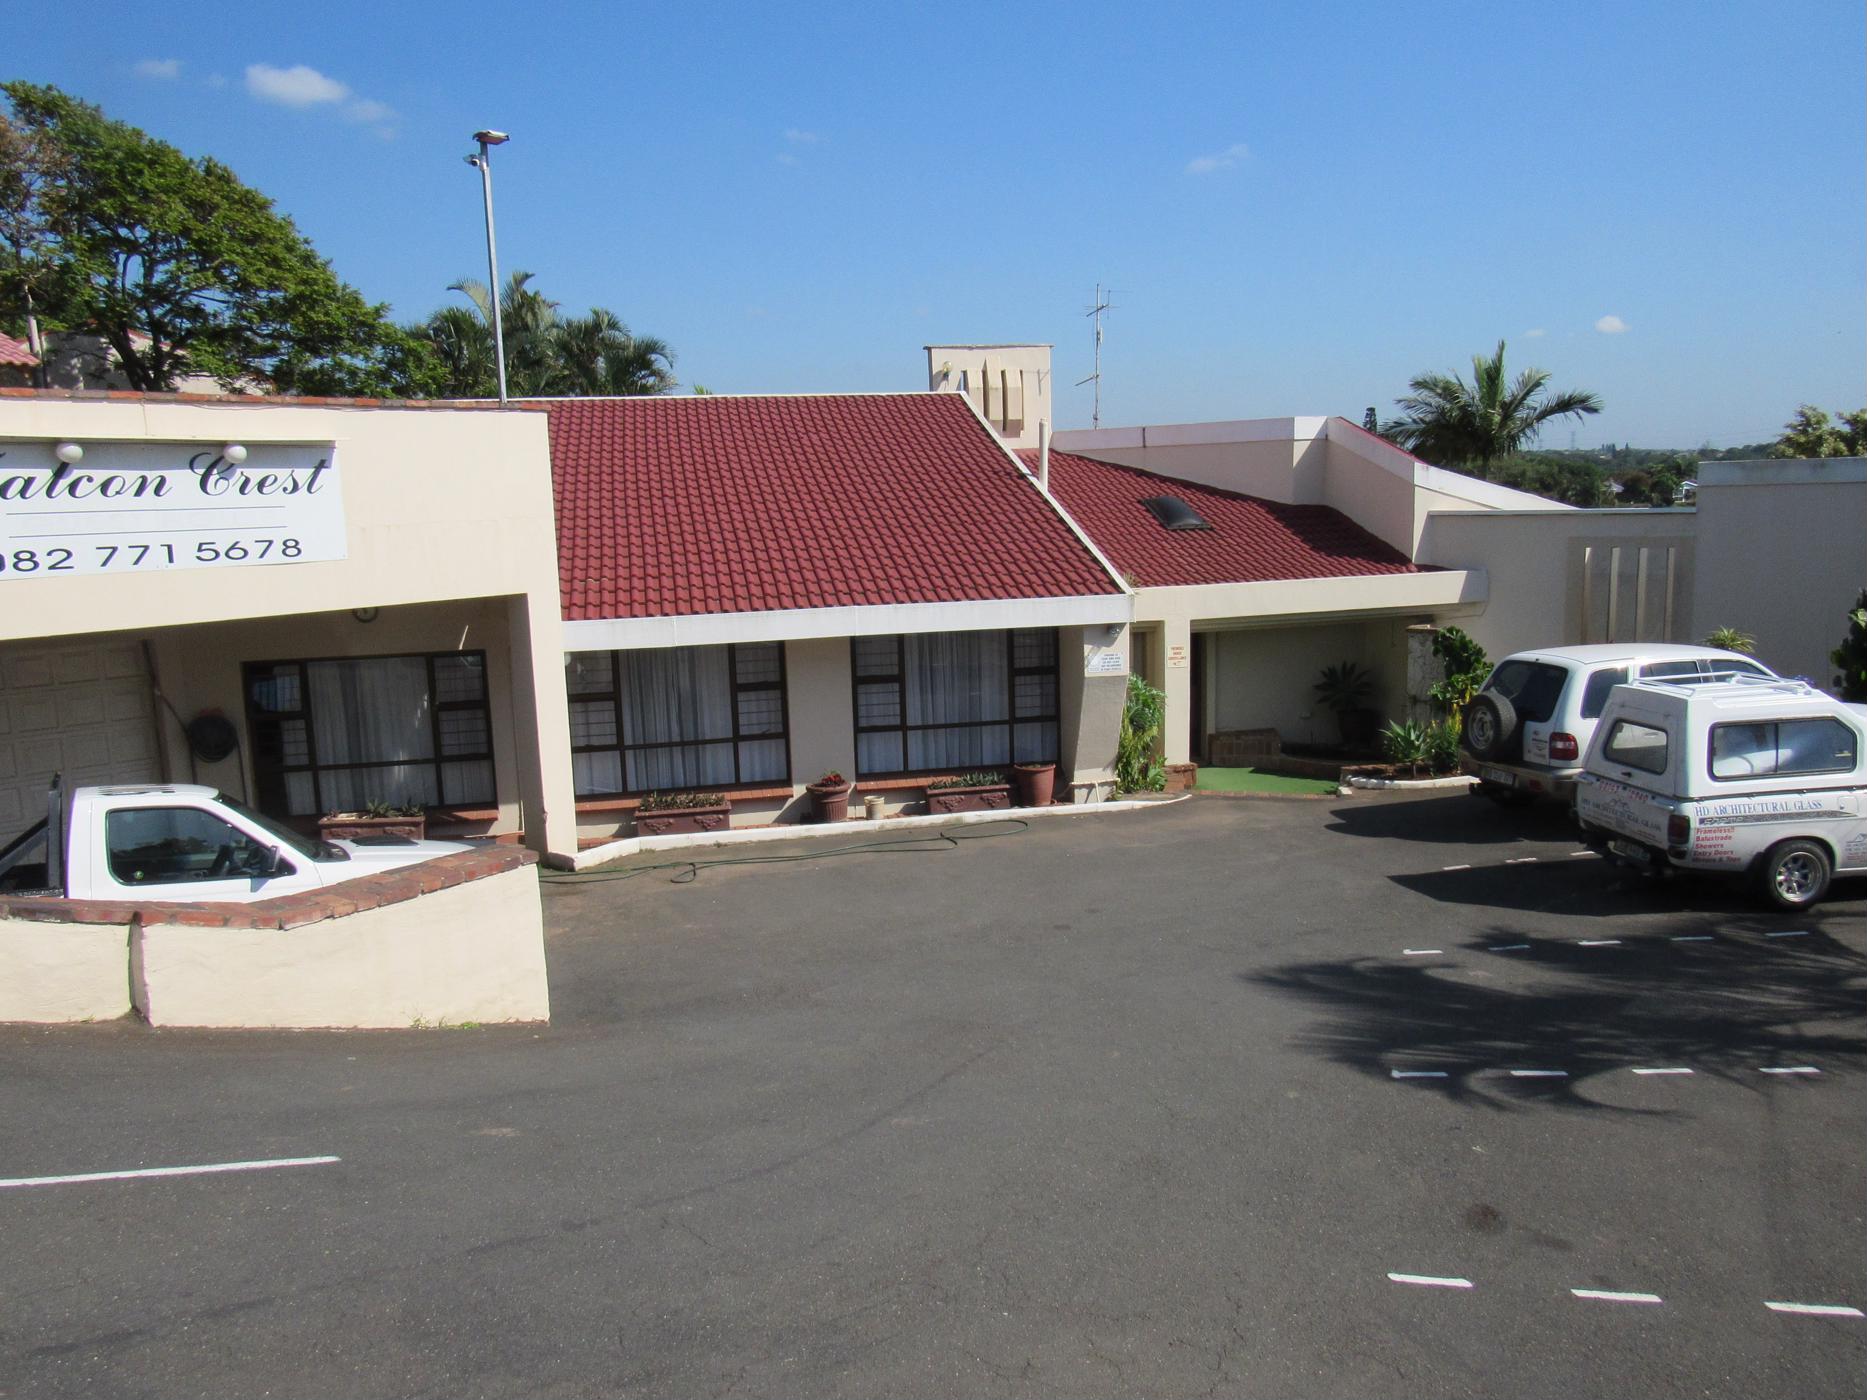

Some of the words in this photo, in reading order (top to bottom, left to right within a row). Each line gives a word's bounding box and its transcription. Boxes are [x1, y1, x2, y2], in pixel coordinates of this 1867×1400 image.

[0, 452, 172, 500] alcon
[188, 452, 328, 497] Crest
[0, 548, 75, 573] 82
[95, 543, 175, 567] 771
[195, 538, 303, 563] 5678
[1695, 805, 1709, 817] HD
[1713, 801, 1791, 816] ARCHITECTURAL
[1793, 799, 1823, 811] GLASS
